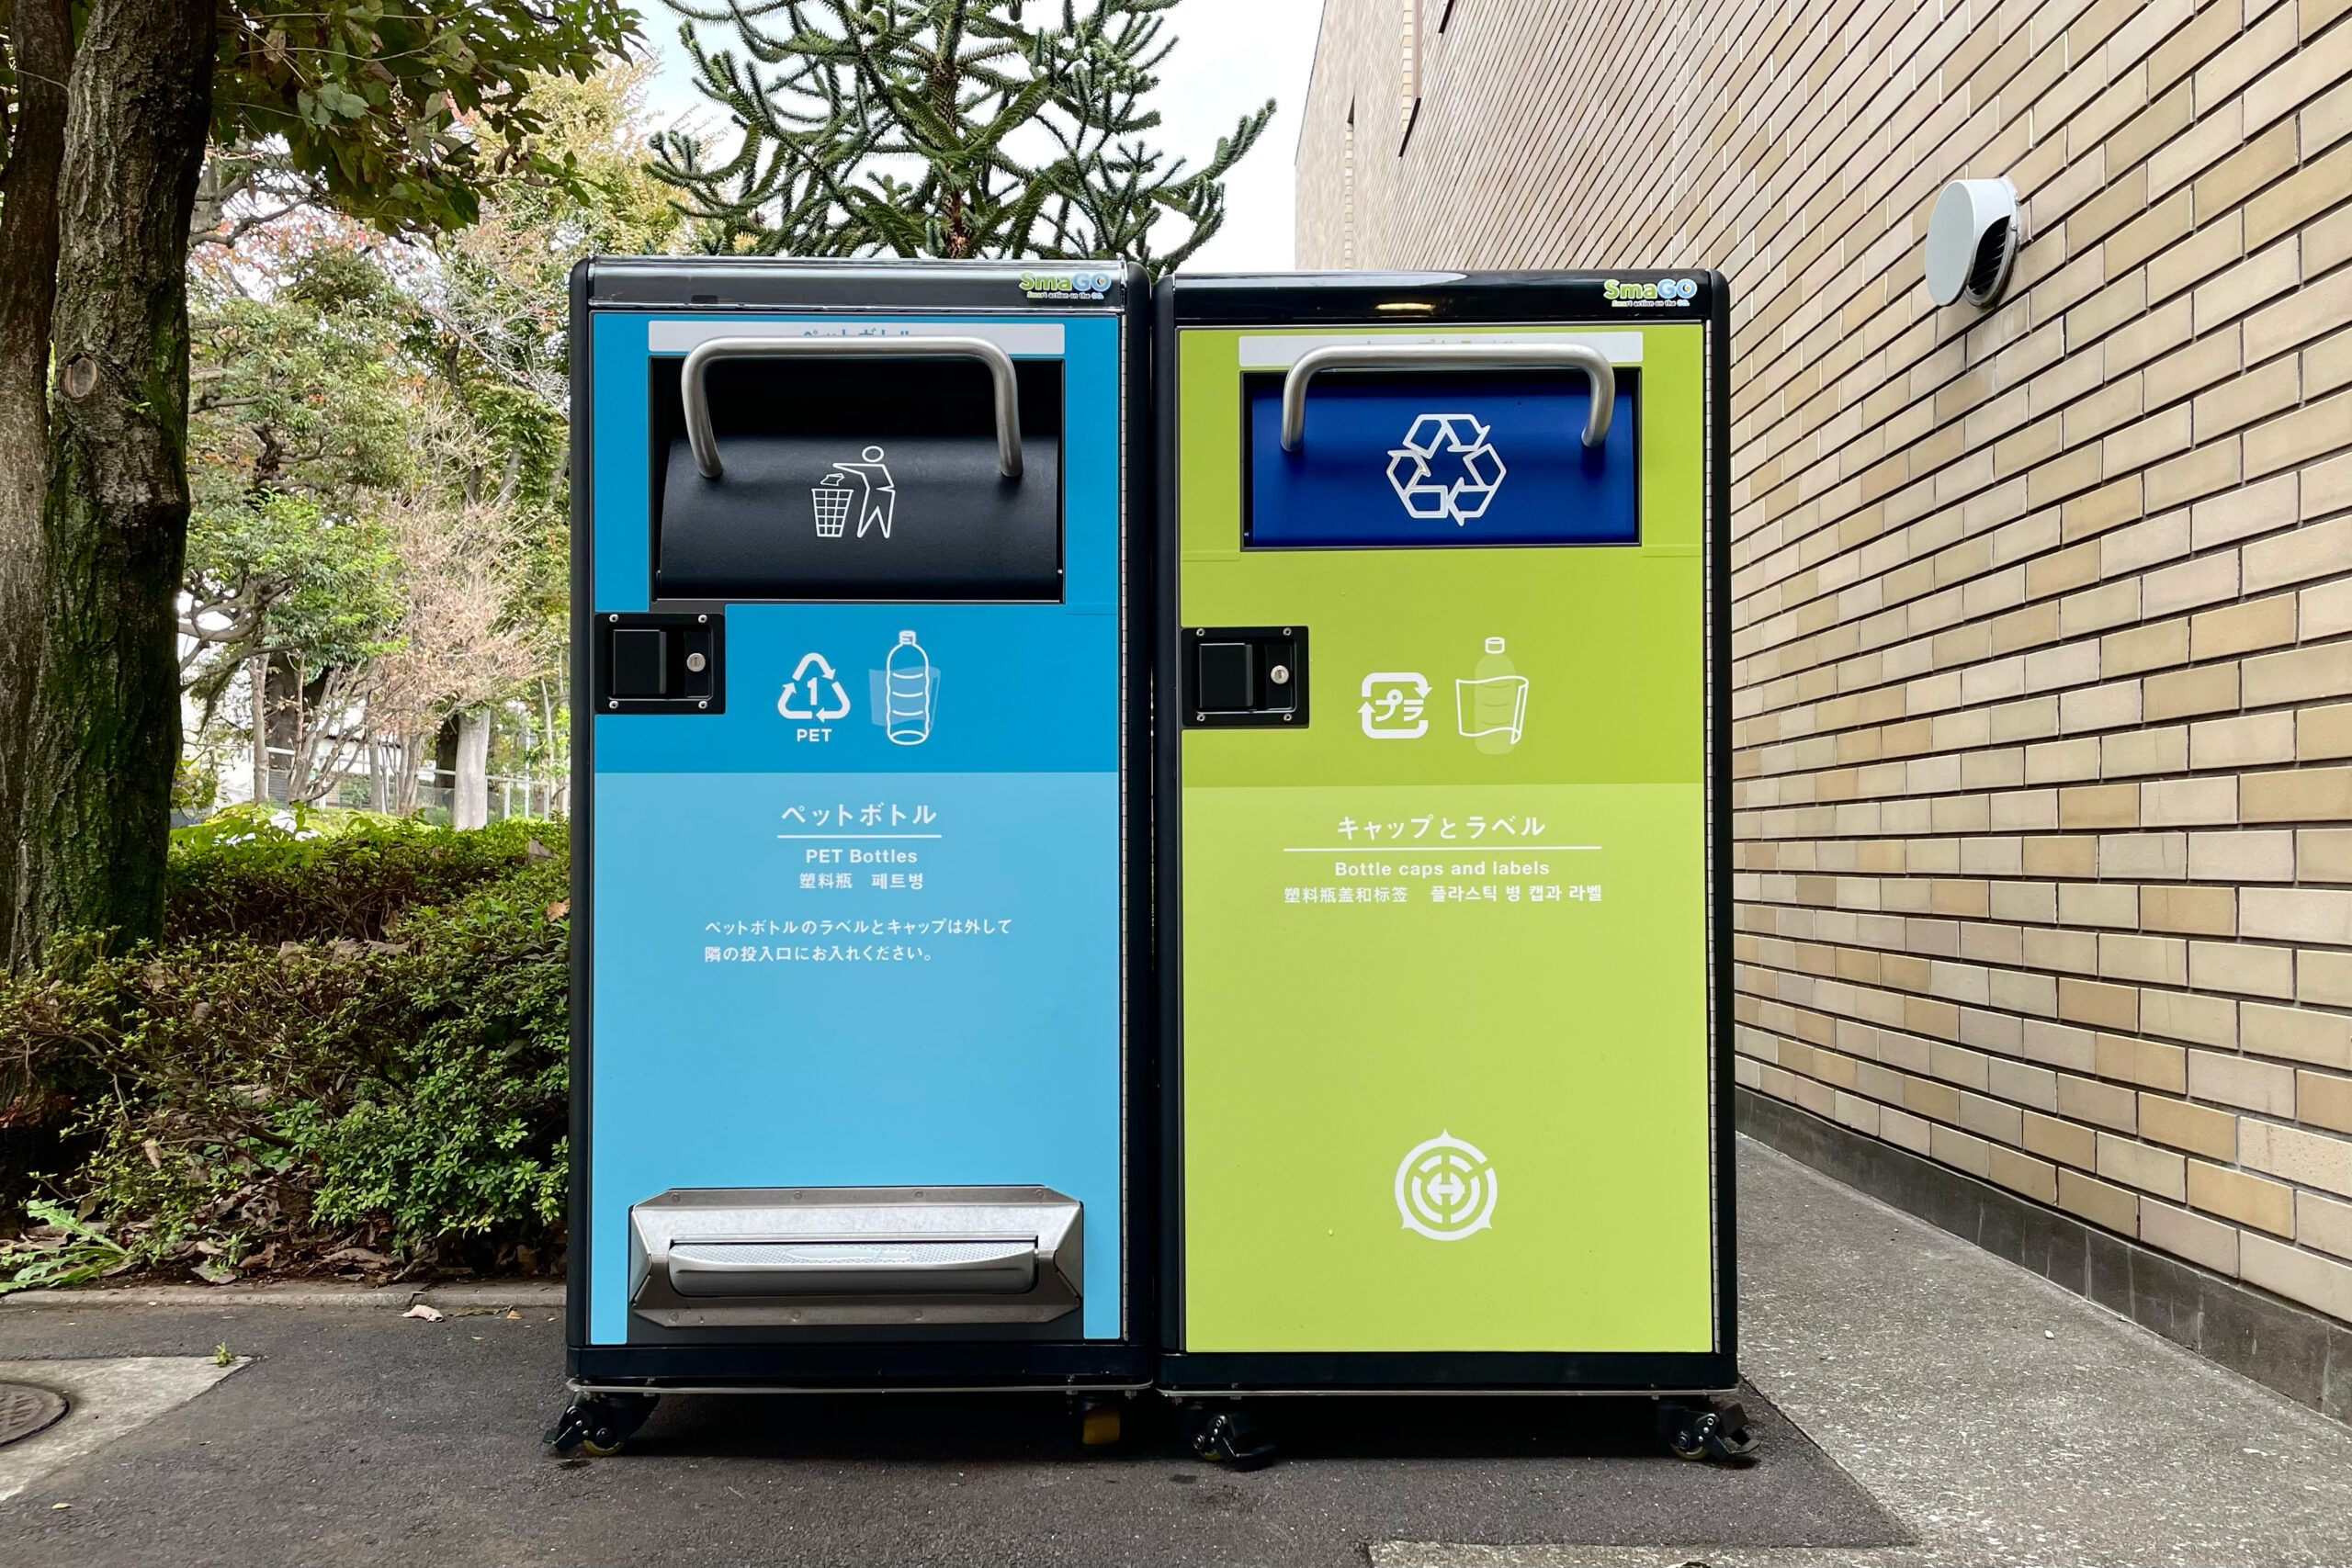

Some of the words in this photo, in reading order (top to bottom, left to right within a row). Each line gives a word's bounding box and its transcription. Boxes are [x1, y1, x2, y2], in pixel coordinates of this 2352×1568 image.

[1019, 272, 1111, 291] SmaGO
[1603, 278, 1697, 299] SmaGO
[1048, 291, 1069, 299] action
[1079, 291, 1091, 299] the
[796, 728, 832, 742] PET
[781, 802, 937, 827] ペットボトル
[1337, 814, 1546, 840] キャップとラベル
[806, 848, 843, 863] PET
[849, 848, 918, 863] Bottles
[1334, 862, 1392, 876] Bottle
[1398, 864, 1444, 879] caps
[1451, 861, 1486, 875] and
[1492, 860, 1550, 875] labels
[799, 872, 853, 889] 塑料瓶
[871, 873, 923, 890] 페트병
[1284, 886, 1408, 903] 塑料瓶盖和标签
[1430, 885, 1497, 903] 플라스틱
[1505, 885, 1521, 902] 병
[1529, 885, 1562, 902] 캡과
[1568, 884, 1601, 902] 라벨
[705, 918, 1012, 935] ペットボトルのラベルとキャップは外して
[705, 945, 931, 963] 隣の投入口にお入れください。
